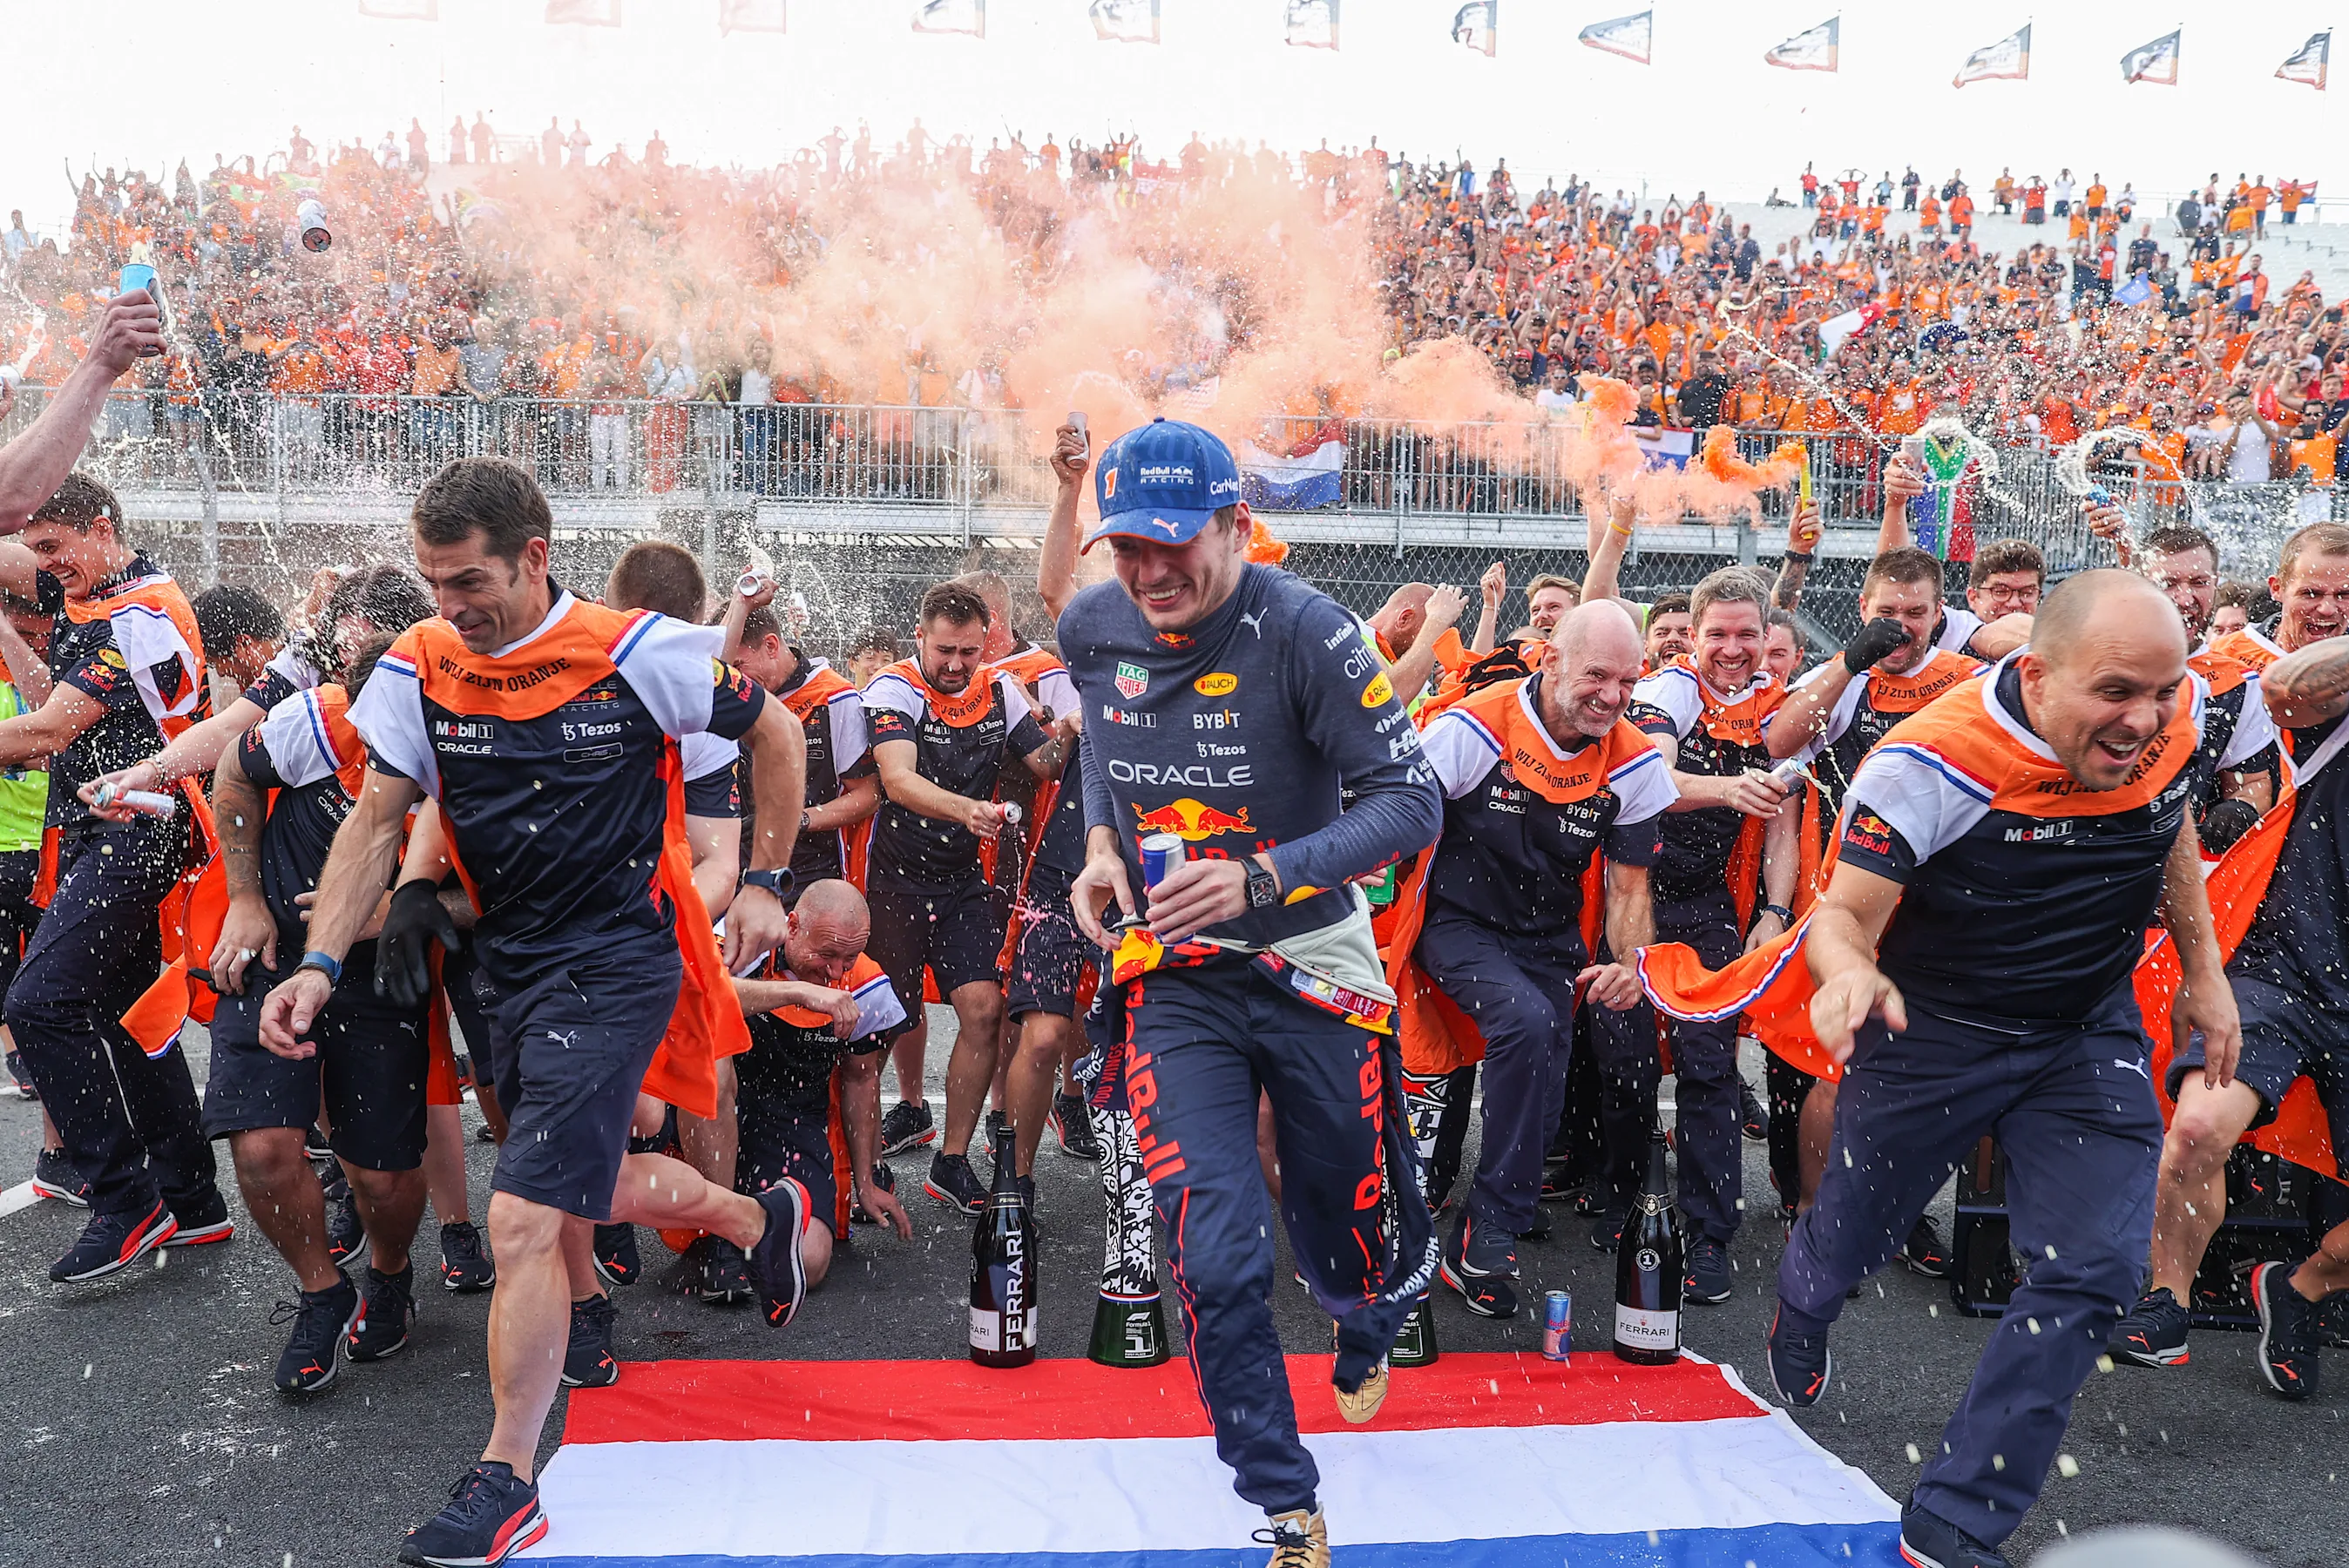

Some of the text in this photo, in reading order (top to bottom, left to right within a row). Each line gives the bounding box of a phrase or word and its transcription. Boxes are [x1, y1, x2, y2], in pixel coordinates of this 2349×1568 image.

[1104, 467, 1119, 500] 1
[438, 655, 572, 693] WIJ ZIJN ORANJE
[1120, 664, 1147, 680] TAG
[1116, 676, 1147, 697] HEUER
[1206, 678, 1234, 689] RAUCH
[1889, 688, 1917, 699] ZIJN
[1919, 672, 1958, 697] ORANJE
[558, 702, 620, 713] RACING
[792, 699, 815, 716] ANJE
[1103, 704, 1139, 727] Mobil
[2203, 706, 2224, 715] ezo
[887, 722, 903, 731] Bull
[1193, 708, 1241, 730] BYBIT
[1731, 718, 1754, 730] ORAN
[436, 720, 477, 739] Mobil
[578, 721, 622, 738] Tezos
[437, 741, 493, 755] ORACLE
[1208, 743, 1247, 757] Tezos
[1684, 736, 1703, 752] Mob
[1680, 748, 1704, 763] ORAC
[1107, 759, 1255, 787] ORACLE
[1501, 767, 1517, 782] HEU
[1514, 747, 1536, 768] WIJ
[1551, 772, 1593, 788] ORANJE
[1491, 785, 1520, 801] Mobil
[2036, 781, 2074, 796] WIJ
[317, 794, 345, 825] ORAC
[324, 787, 356, 816] Mobi
[1488, 801, 1527, 814] ORACLE
[1566, 803, 1601, 823] BYBIT
[2004, 822, 2055, 842] Mobil
[1846, 828, 1891, 855] Red Bull
[1100, 1042, 1125, 1084] WINGS
[1127, 1067, 1187, 1186] Bull
[1642, 1254, 1653, 1266] 1
[1005, 1229, 1022, 1353] FERRARI
[970, 1323, 990, 1336] RARI
[1620, 1321, 1669, 1336] FERRARI
